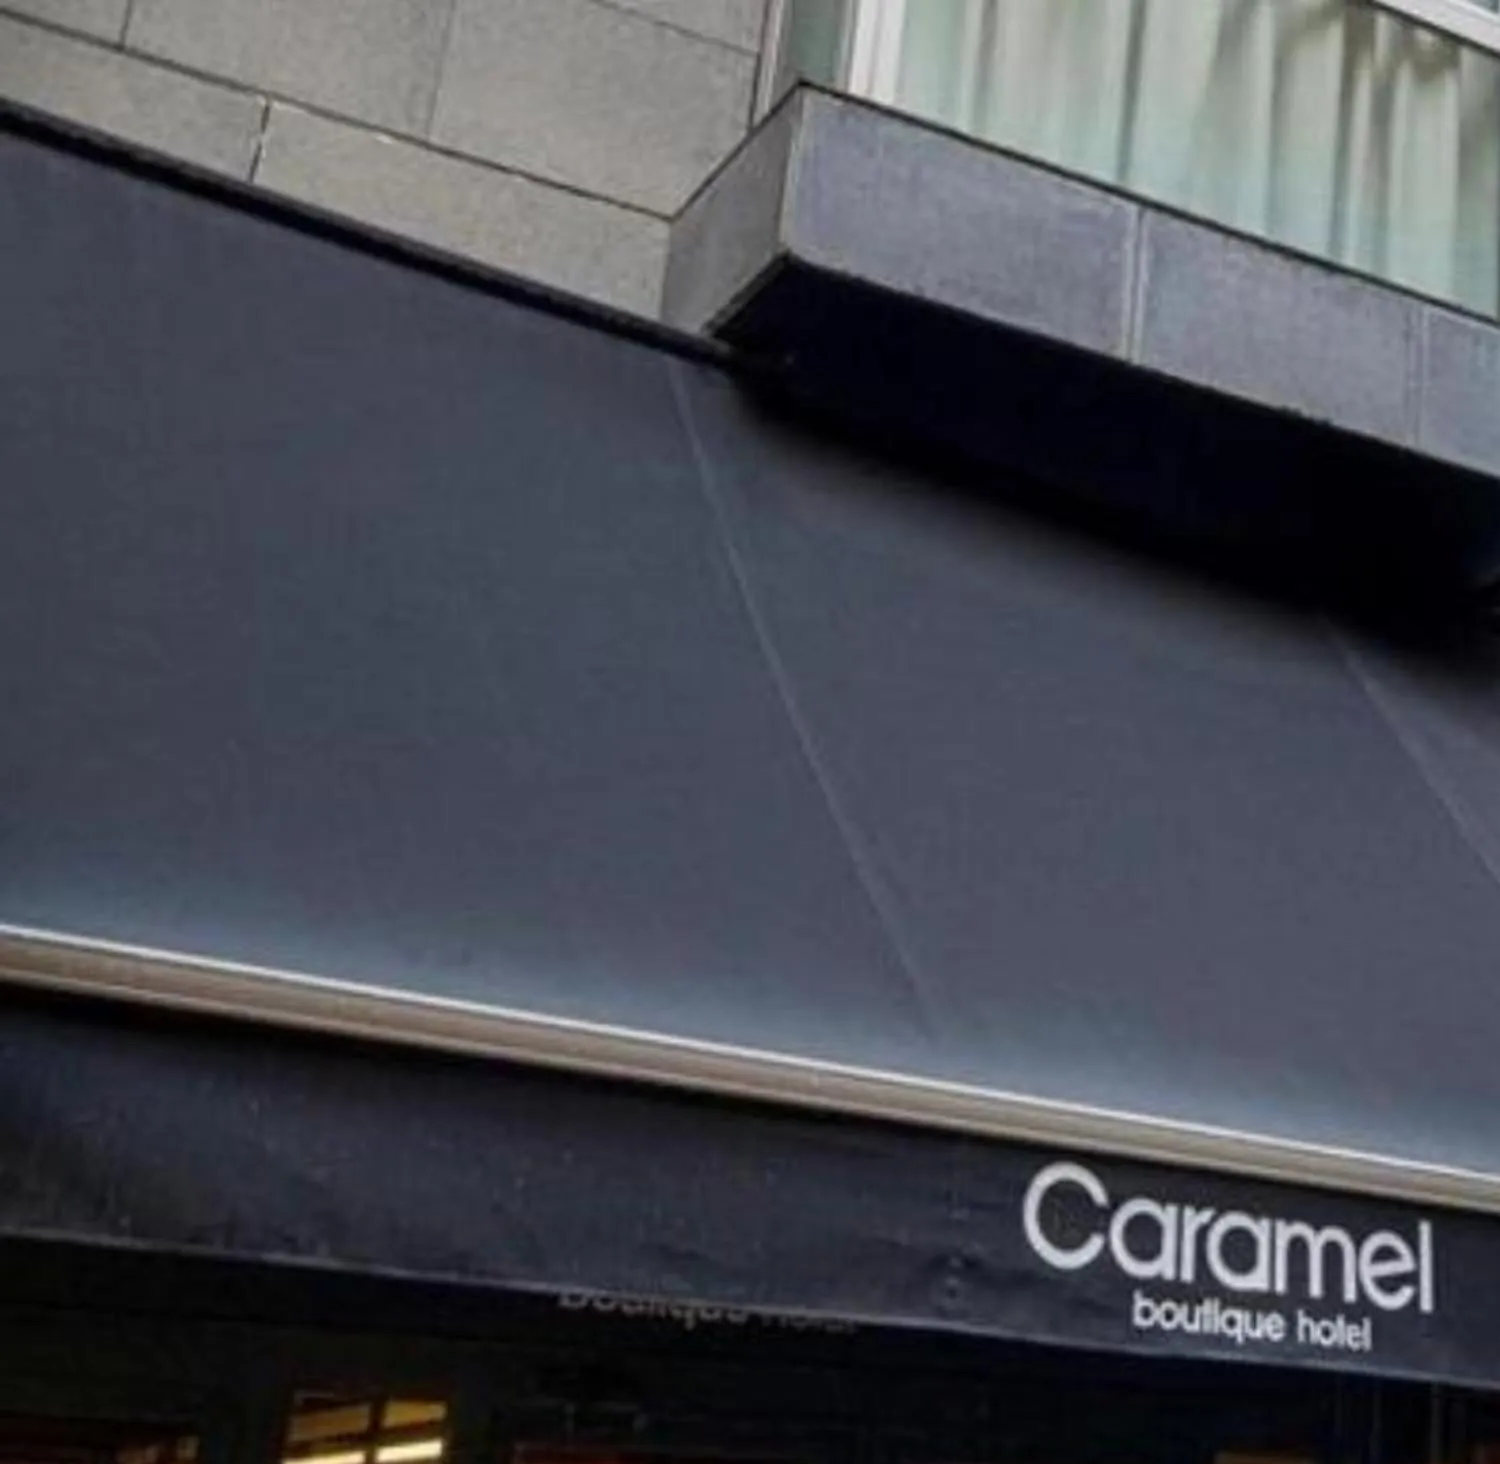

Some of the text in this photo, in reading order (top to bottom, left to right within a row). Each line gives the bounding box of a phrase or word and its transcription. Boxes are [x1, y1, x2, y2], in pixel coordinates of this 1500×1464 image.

[1023, 1161, 1433, 1313] Caramel
[1132, 1291, 1372, 1350] boutique hotel
